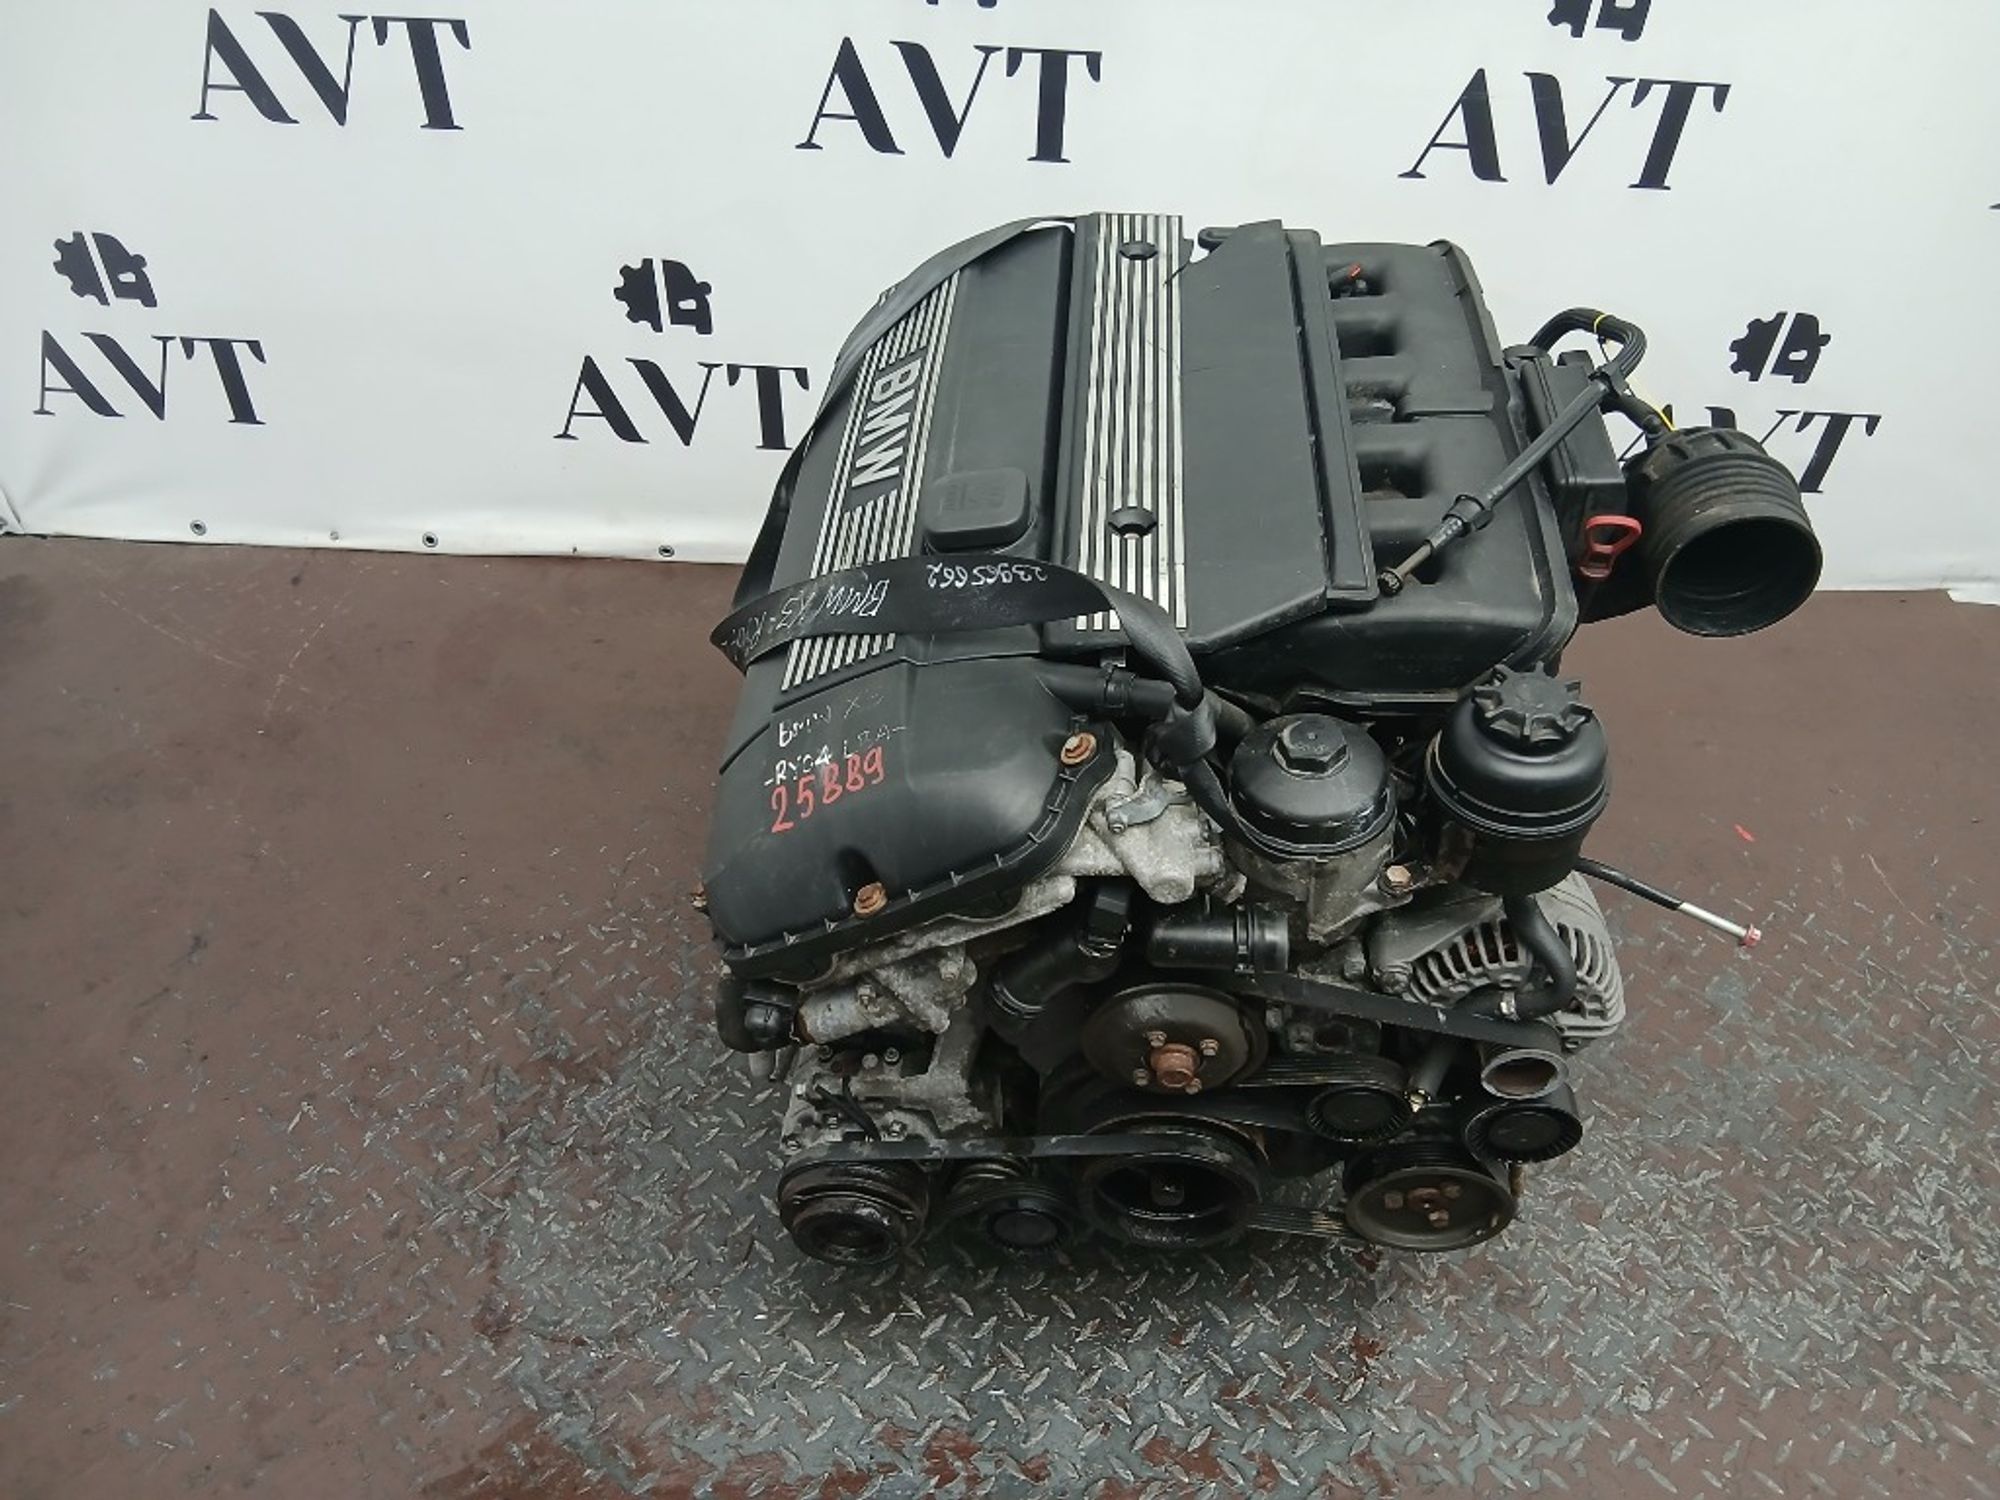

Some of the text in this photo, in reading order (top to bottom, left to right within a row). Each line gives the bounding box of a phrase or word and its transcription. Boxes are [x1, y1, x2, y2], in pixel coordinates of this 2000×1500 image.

[192, 9, 470, 130] AVT
[796, 37, 1102, 163] AVT
[1399, 69, 1731, 190] AVT
[34, 331, 266, 424] AVT
[554, 356, 809, 451] AVT
[851, 358, 922, 488] BMW
